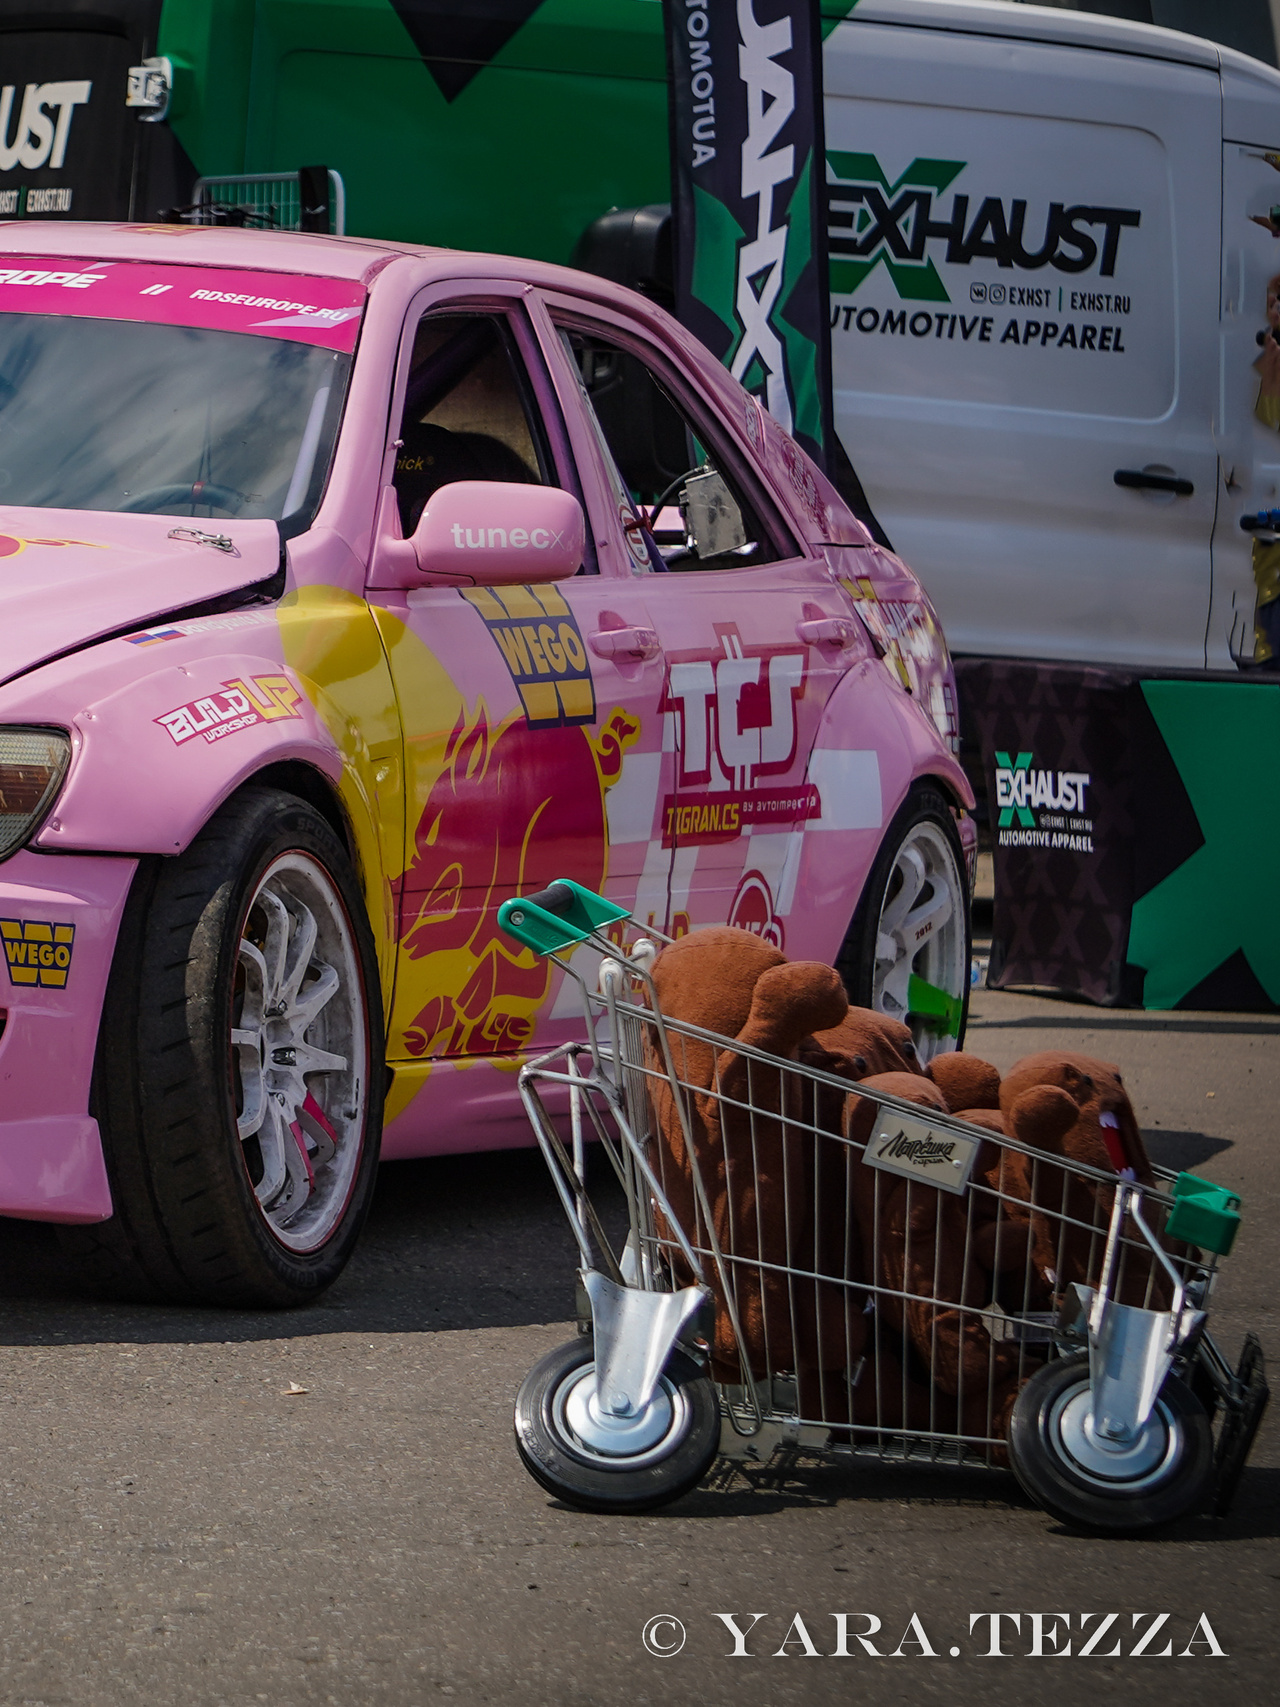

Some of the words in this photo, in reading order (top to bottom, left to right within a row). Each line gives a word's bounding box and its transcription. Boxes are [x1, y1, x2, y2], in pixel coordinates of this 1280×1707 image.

[826, 183, 1141, 277] EXHAUST
[190, 289, 349, 321] RDSEUROPE.RU
[1010, 287, 1051, 307] EXHST
[1071, 292, 1131, 314] EXHST.RU
[830, 305, 994, 342] UTOMOTIVE
[1001, 319, 1125, 352] APPAREL
[491, 622, 586, 676] WEGO
[157, 687, 250, 742] BUILD
[227, 676, 301, 720] UP
[203, 713, 258, 741] WORKSHOP
[996, 768, 1090, 813] EXHAUST
[999, 830, 1051, 848] AUTOMOTIVE
[1051, 832, 1094, 853] APPAREL
[6, 942, 71, 968] WEGO
